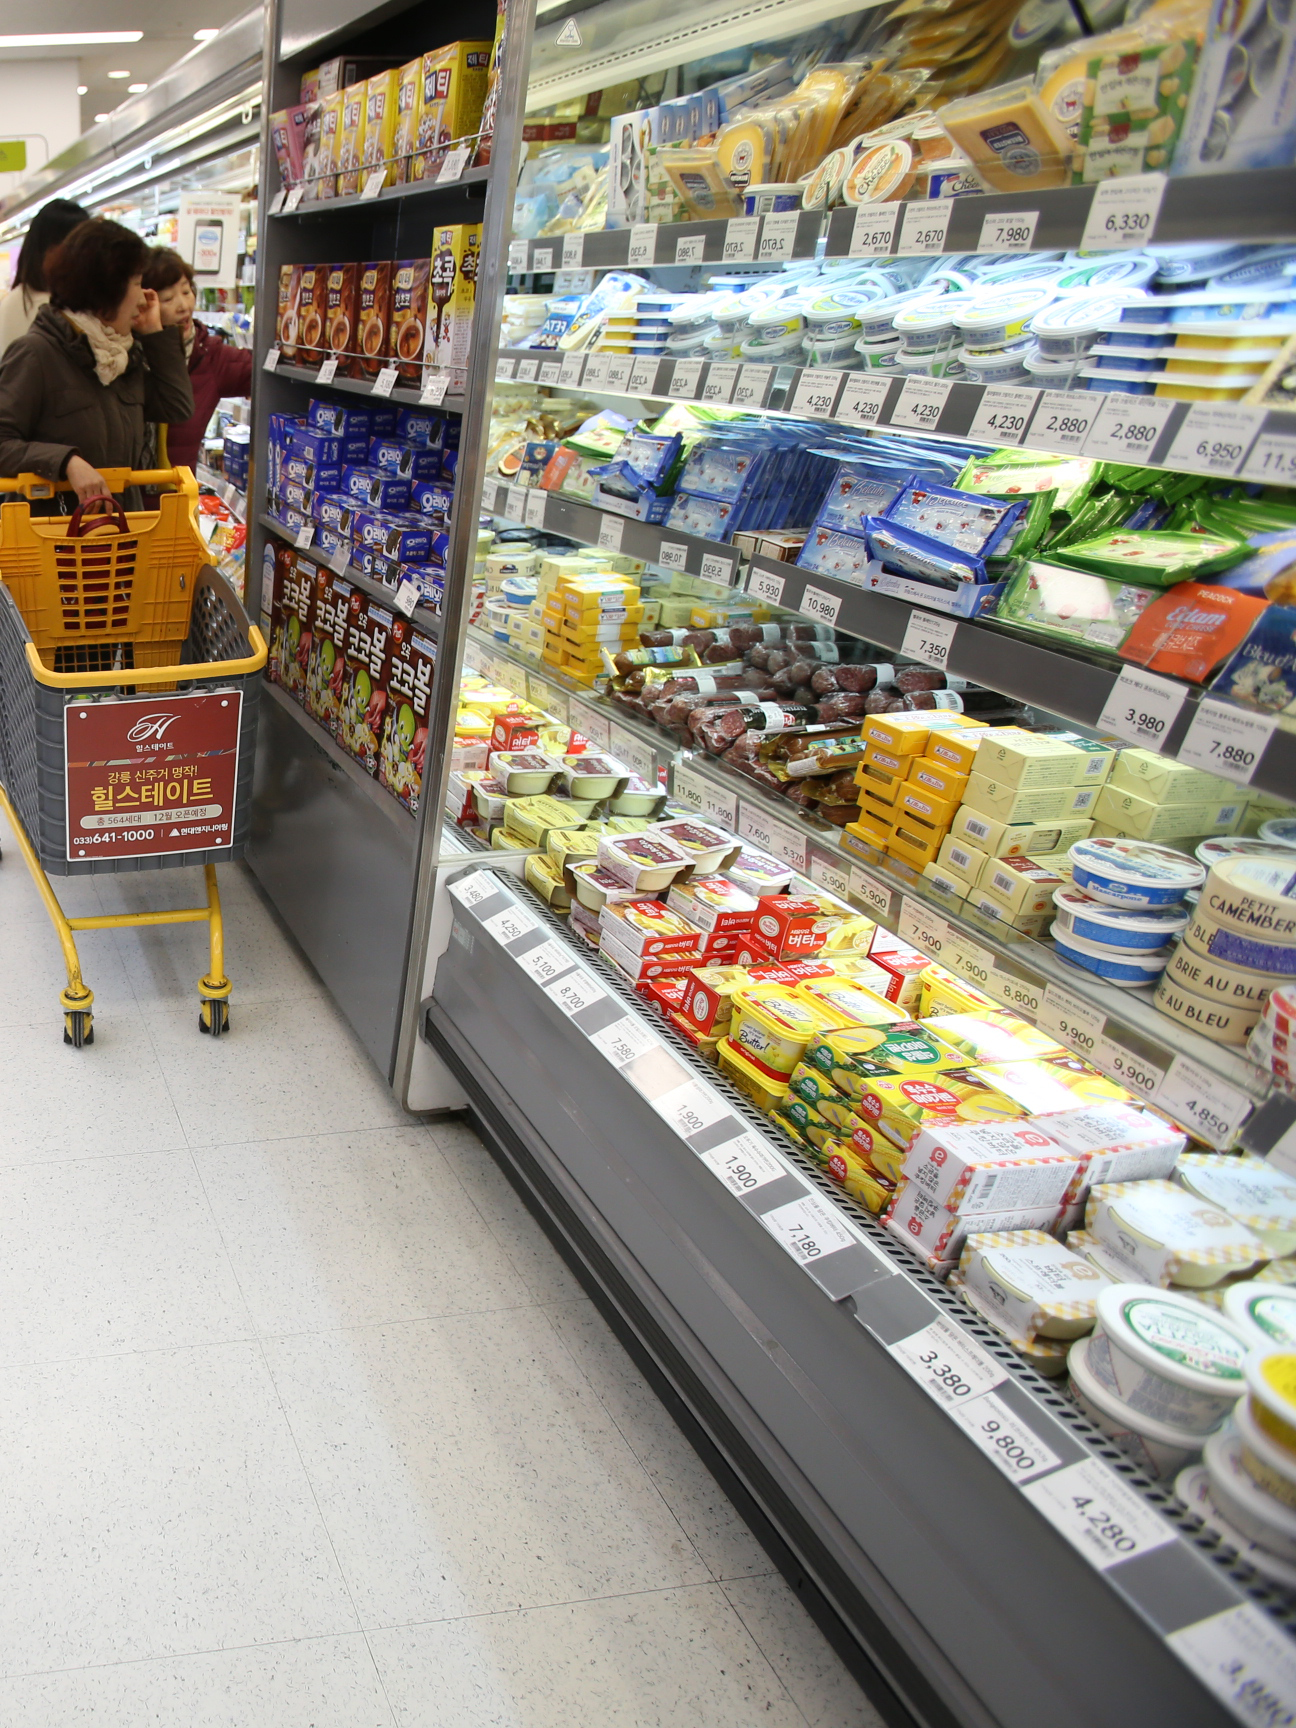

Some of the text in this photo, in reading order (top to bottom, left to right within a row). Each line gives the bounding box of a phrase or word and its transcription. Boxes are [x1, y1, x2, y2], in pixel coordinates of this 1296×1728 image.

[424, 69, 451, 104] 제티
[368, 93, 385, 123] 제티
[1105, 214, 1150, 232] 6,330
[863, 231, 890, 247] 2,670
[915, 230, 943, 245] 2,670
[996, 227, 1030, 242] 7,980
[807, 395, 831, 408] 4,230
[853, 401, 879, 415] 4,230
[912, 403, 940, 418] 4,230
[987, 414, 1024, 431] 4,230
[1047, 416, 1087, 433] 2,880
[1110, 423, 1156, 441] 2,880
[379, 448, 402, 466] 오레오
[1196, 441, 1241, 460] 6,950
[1263, 452, 1296, 471] 11,9
[350, 478, 371, 493] 오레오
[364, 526, 387, 544] 오레오
[758, 581, 780, 597] 5,930
[1197, 590, 1235, 604] PEACOCK
[283, 578, 311, 622] 코코볼
[807, 598, 835, 618] 10,980
[315, 598, 348, 647] 코코볼
[1165, 606, 1226, 626] Edam
[348, 626, 386, 679] 코코볼
[919, 639, 947, 658] 7,350
[390, 657, 431, 715] 코코볼
[1125, 709, 1165, 733] 3,980
[136, 742, 174, 752] 힐스테이트
[1209, 741, 1254, 766] 7,880
[108, 766, 198, 784] 강릉 신주거 명작!
[91, 778, 213, 811] 힐스테이트
[676, 784, 702, 804] 11,800
[96, 809, 207, 826] 총 564세대 12월 오픈예정
[706, 800, 732, 822] 11,800
[74, 829, 154, 844] 033)641-1000
[181, 824, 228, 836] 현대엔지니어링
[748, 823, 770, 844] 7,600
[783, 845, 804, 864] 5,370
[822, 871, 846, 892] 5,900
[464, 884, 483, 902] 3,480
[860, 884, 886, 909] 5,900
[1091, 884, 1143, 903] Mascarpone
[1241, 897, 1279, 915] PETIT
[501, 919, 521, 938] 4,250
[911, 924, 942, 950] 7,900
[678, 939, 694, 949] 버터
[788, 934, 815, 947] 버터
[532, 954, 555, 976] 5,100
[955, 953, 988, 983] 7,900
[1175, 957, 1229, 991] BRIE AU
[560, 986, 585, 1009] 8,700
[1004, 985, 1038, 1010] 8,800
[1166, 995, 1230, 1028] AU BLEU
[739, 1029, 770, 1053] Butter!
[1059, 1020, 1095, 1049] 9,900
[610, 1037, 635, 1060] 7,580
[1113, 1057, 1155, 1091] 9,900
[676, 1103, 704, 1130] 1,900
[1184, 1098, 1229, 1135] 4,850
[723, 1155, 757, 1188] 1,900
[788, 1223, 821, 1257] 7,180
[920, 1351, 971, 1397] 3,380
[980, 1419, 1034, 1470] 9,800
[1072, 1495, 1135, 1552] 4,280
